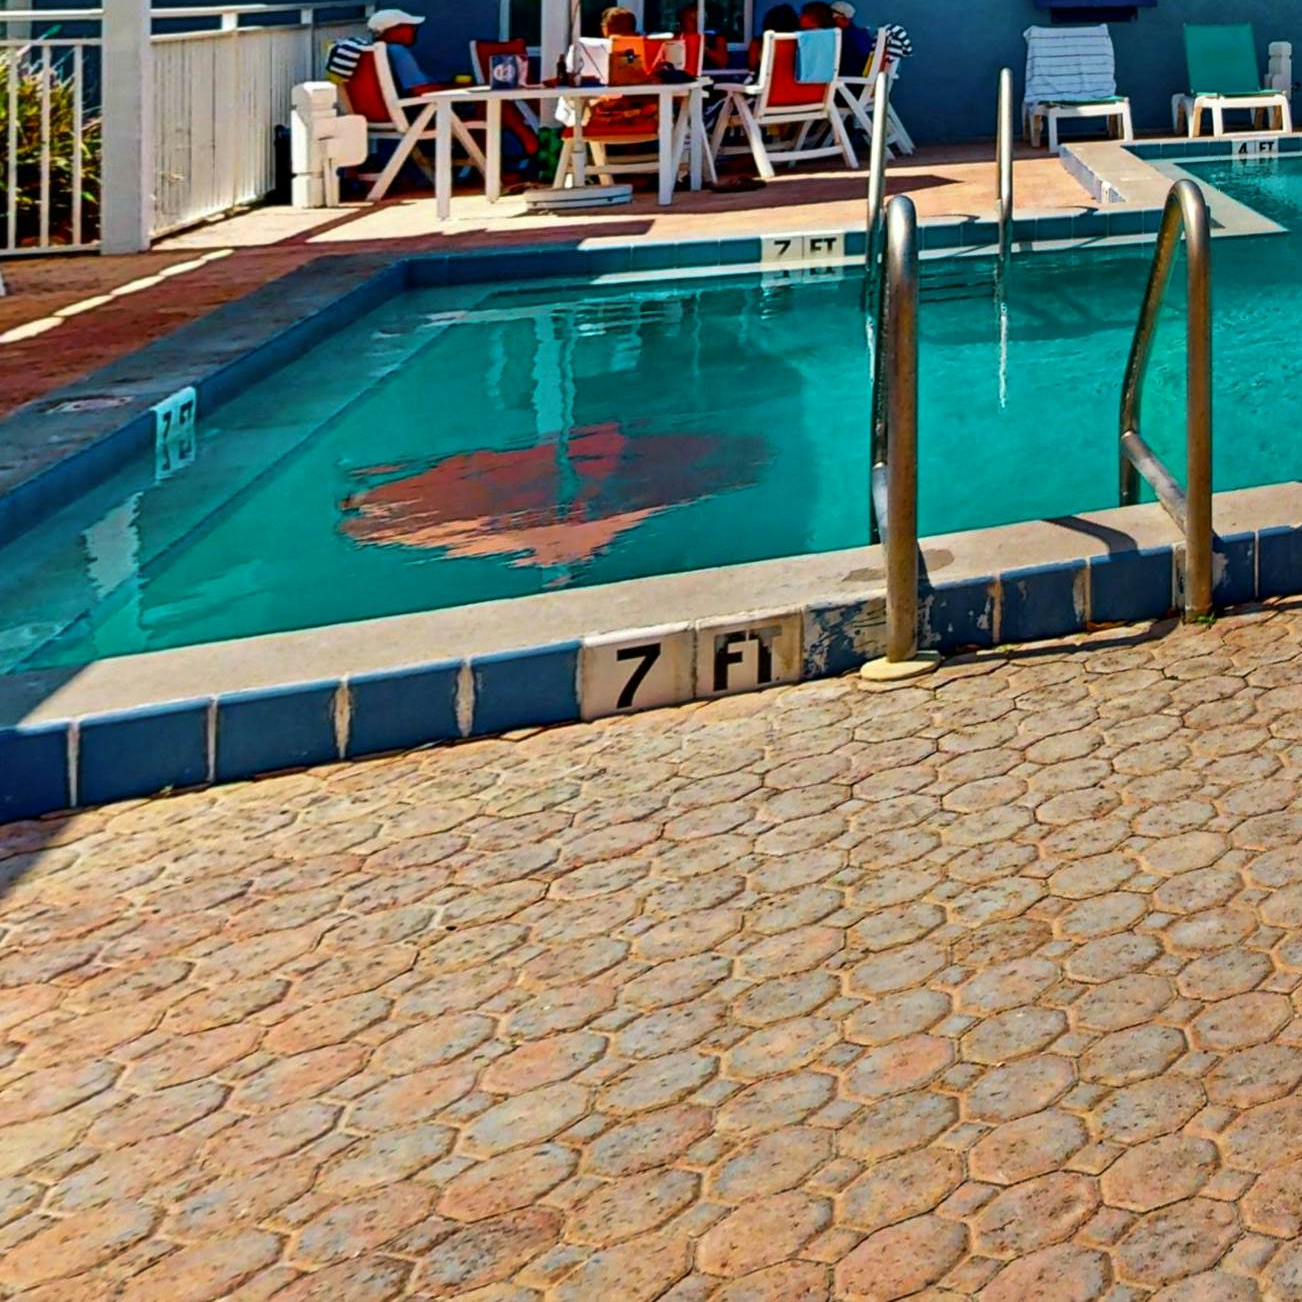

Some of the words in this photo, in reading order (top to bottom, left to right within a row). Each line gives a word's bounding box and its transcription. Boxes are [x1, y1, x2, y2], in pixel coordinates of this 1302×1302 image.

[1239, 142, 1248, 155] 4
[1259, 141, 1274, 153] FT
[774, 239, 791, 258] 7
[810, 237, 837, 254] FT
[616, 643, 661, 709] 7
[713, 626, 782, 692] FT
